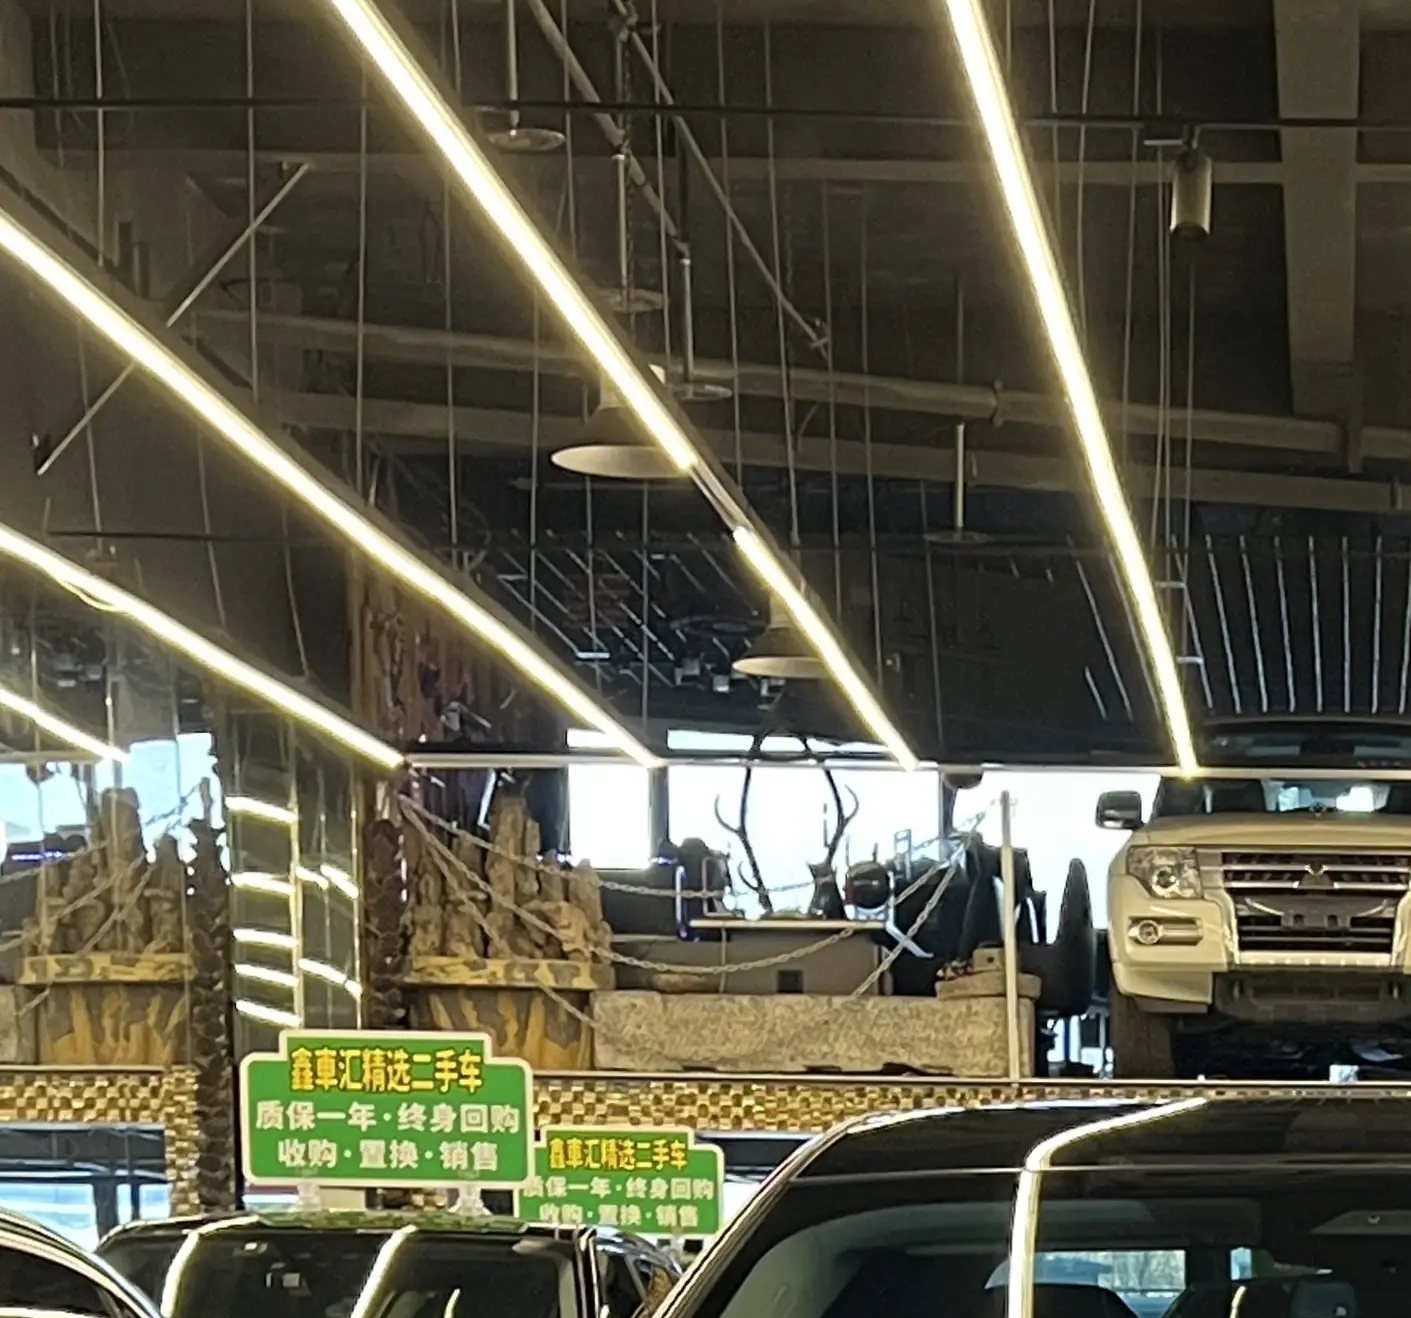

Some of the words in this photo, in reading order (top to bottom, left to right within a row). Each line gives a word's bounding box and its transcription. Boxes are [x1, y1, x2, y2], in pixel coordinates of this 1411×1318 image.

[291, 1047, 483, 1094] 鑫車汇精选二手车
[256, 1101, 520, 1133] 质保一年·终身回购
